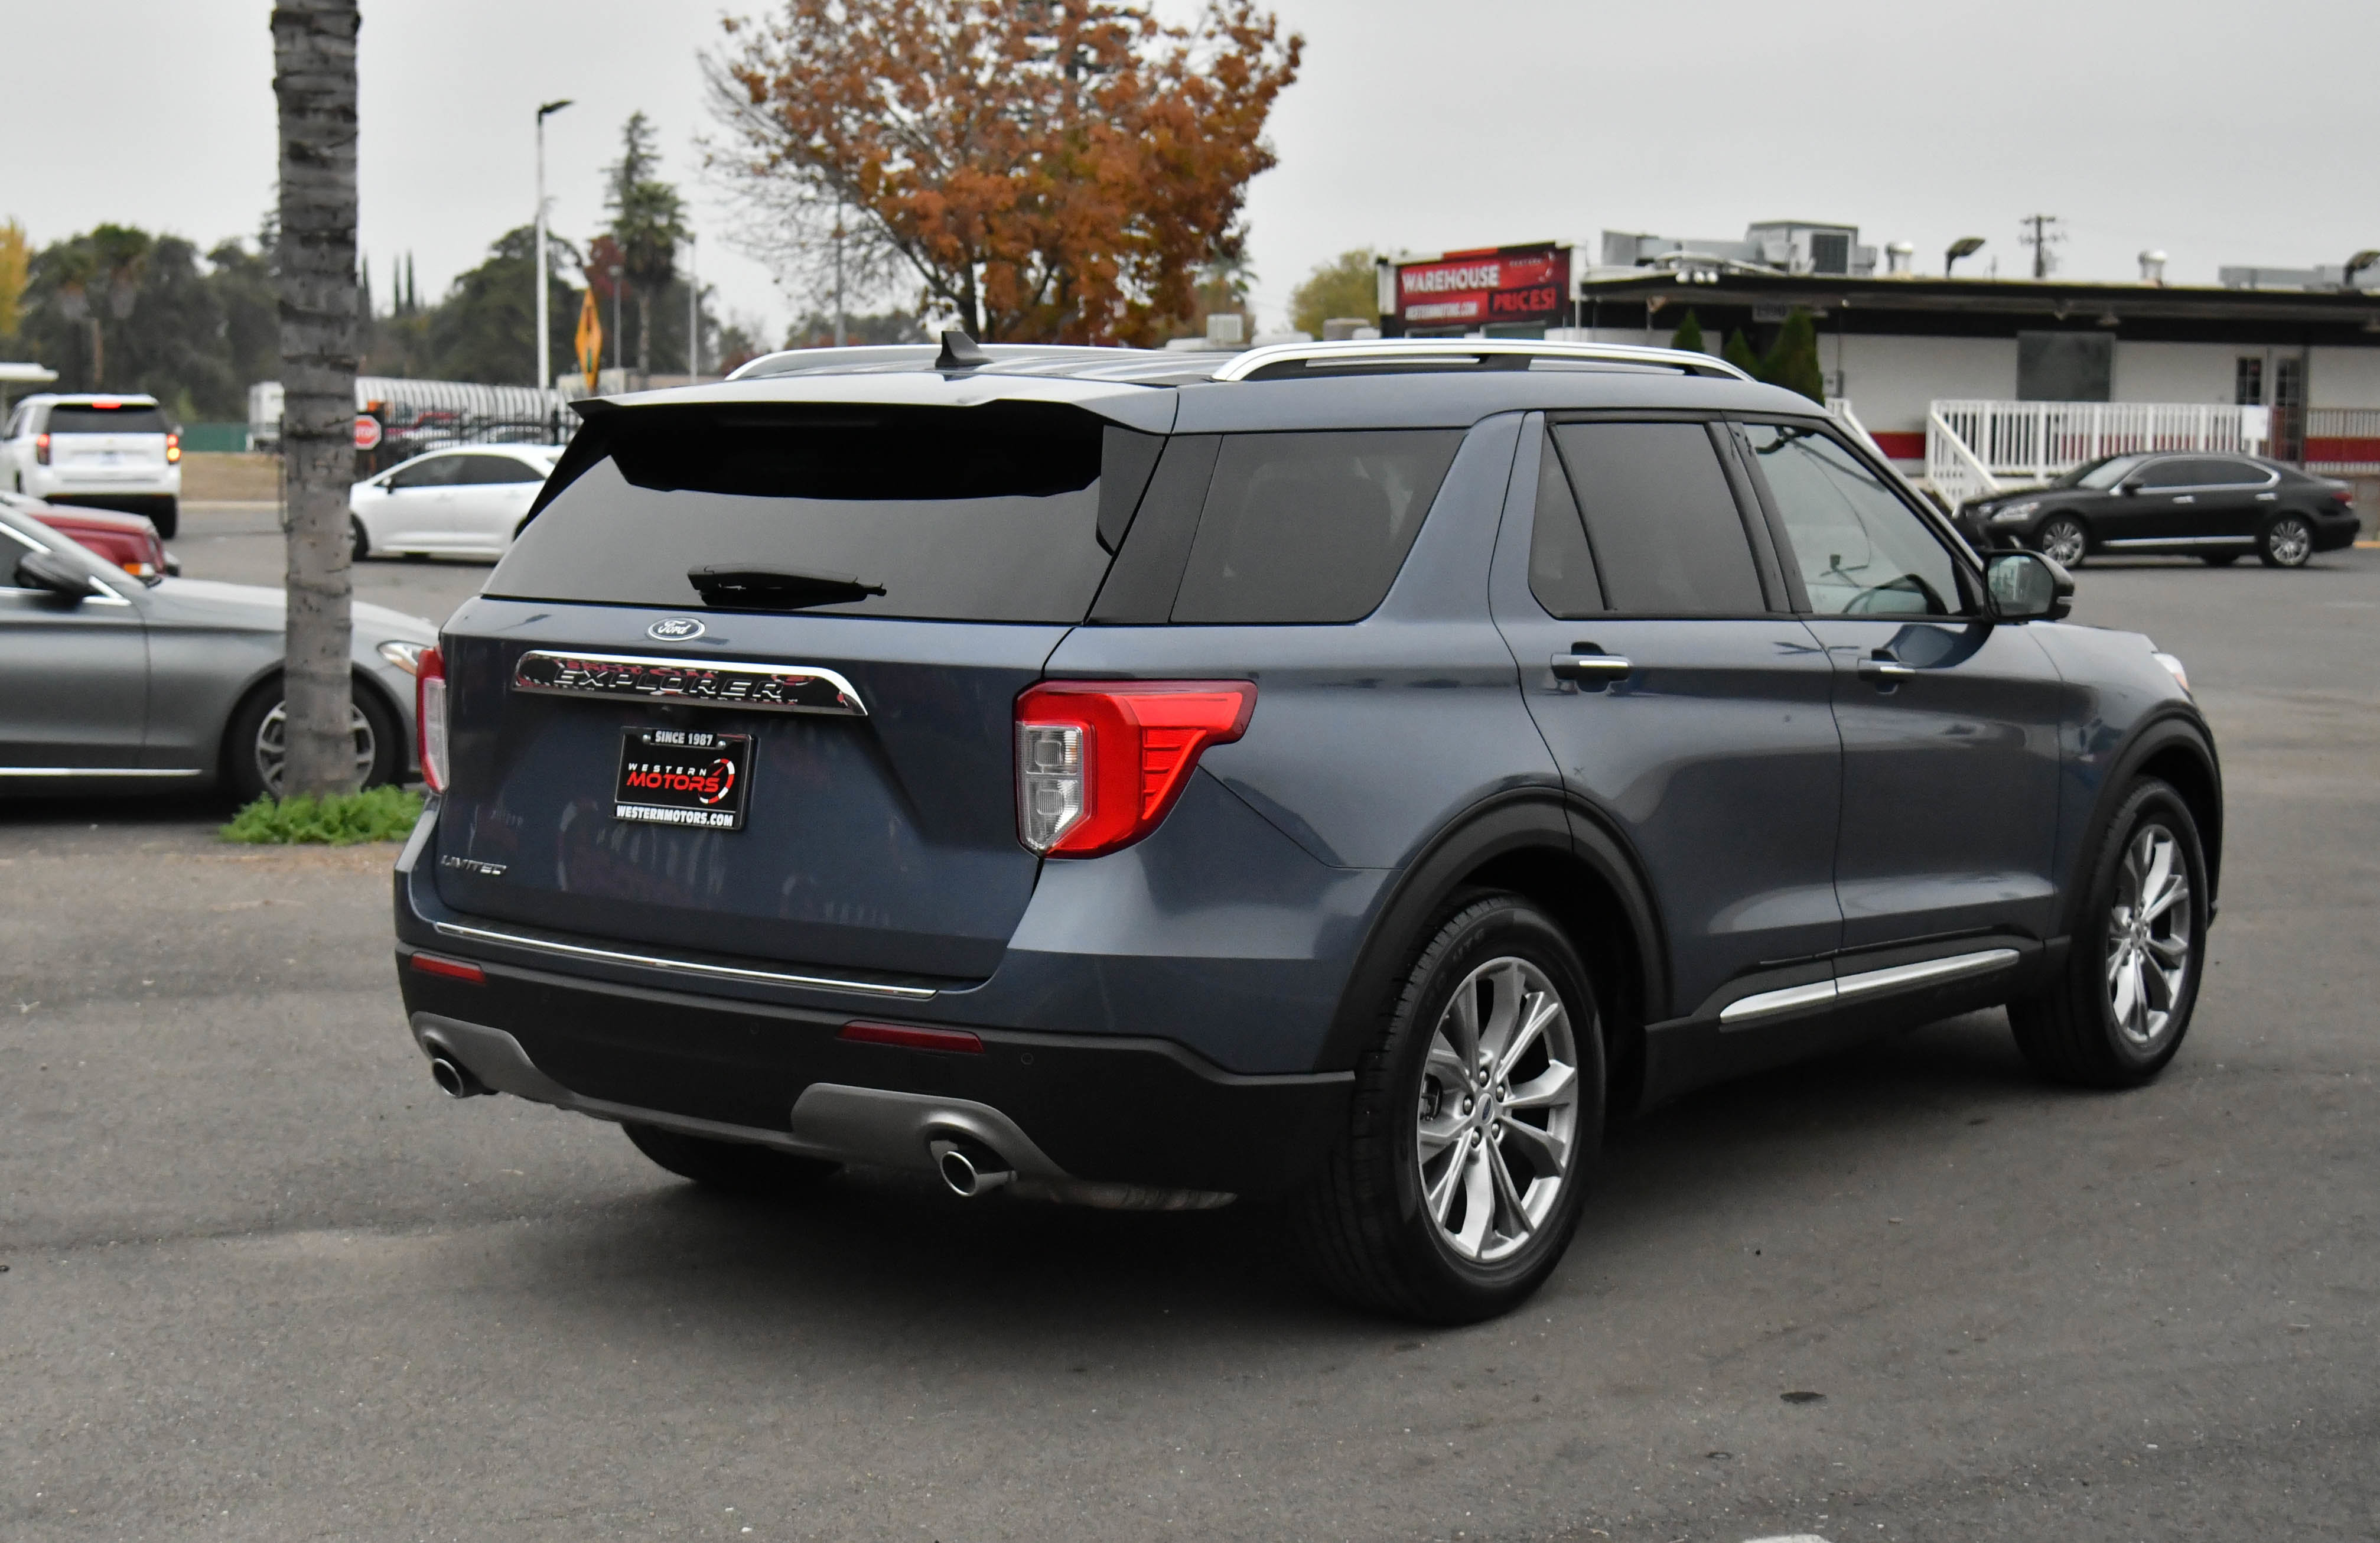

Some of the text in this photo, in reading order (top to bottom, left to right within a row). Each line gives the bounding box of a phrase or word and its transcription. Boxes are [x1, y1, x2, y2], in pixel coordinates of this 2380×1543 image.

[1402, 264, 1500, 294] WAREHOUSE
[657, 620, 691, 635] Ford
[553, 669, 784, 699] EXPLORER
[655, 731, 714, 746] SINCE 1987
[628, 763, 707, 776] WESTERN
[626, 771, 720, 793] MOTORS
[616, 805, 734, 826] WESTERNMOTORS.COM
